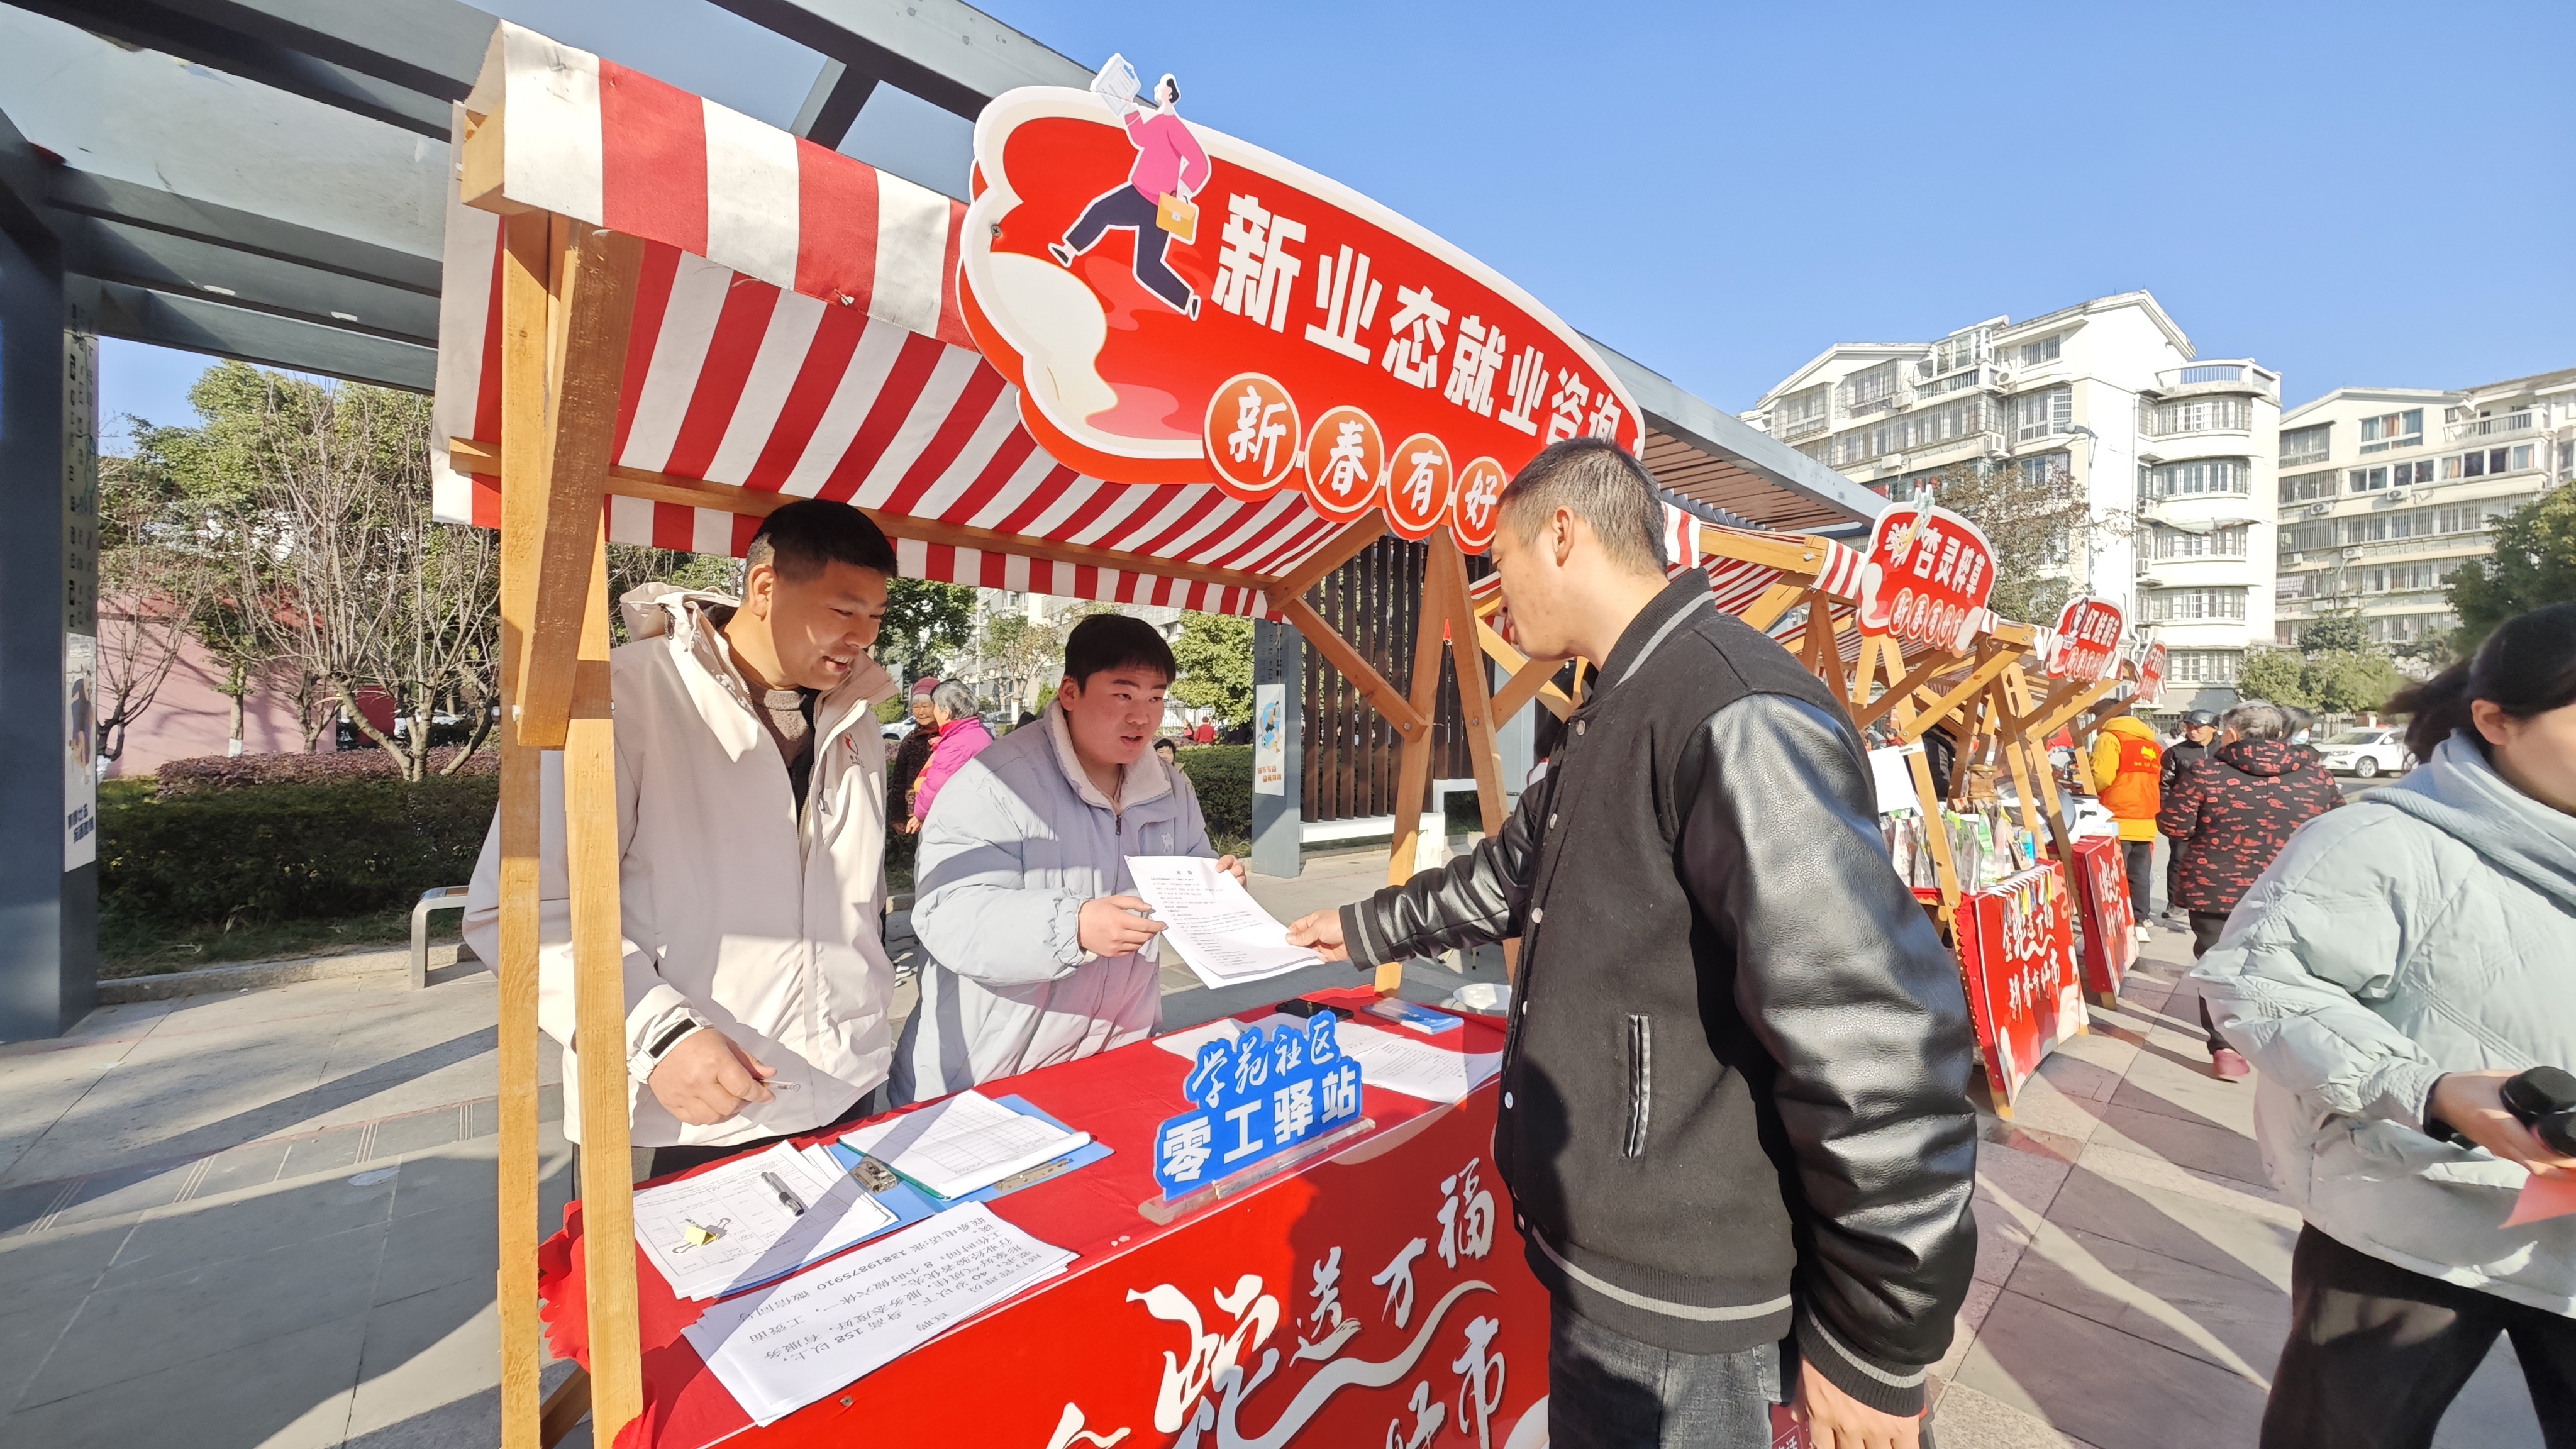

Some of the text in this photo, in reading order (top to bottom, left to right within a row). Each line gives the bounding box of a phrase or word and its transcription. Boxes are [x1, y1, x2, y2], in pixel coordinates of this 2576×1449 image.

[1210, 194, 1621, 446] 新业态就业咨询
[1227, 385, 1498, 531] 新春有好
[1162, 1065, 1356, 1182] 零工驿站
[1191, 1020, 1335, 1109] 学苑社区
